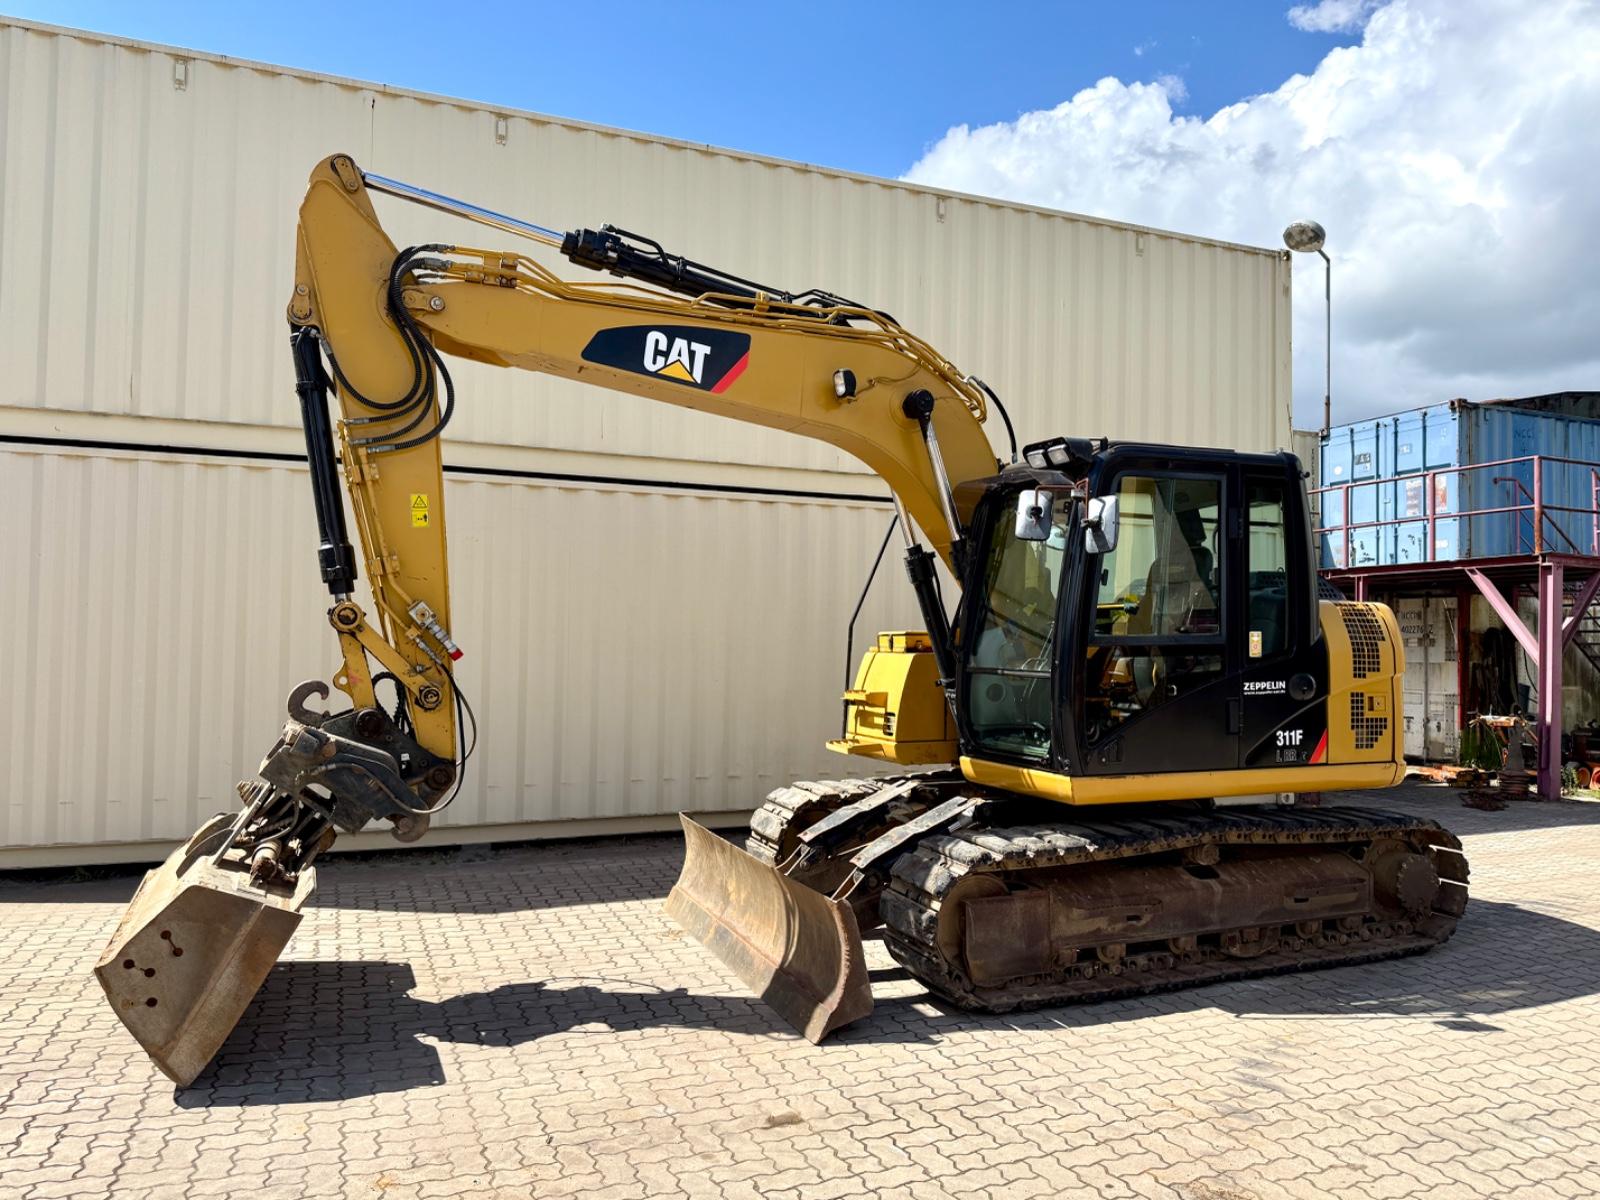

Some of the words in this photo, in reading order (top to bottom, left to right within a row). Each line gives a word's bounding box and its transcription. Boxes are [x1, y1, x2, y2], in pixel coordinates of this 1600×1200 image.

[643, 330, 711, 384] CAT
[1243, 681, 1286, 690] ZEPPELIN
[1276, 729, 1303, 746] 311F
